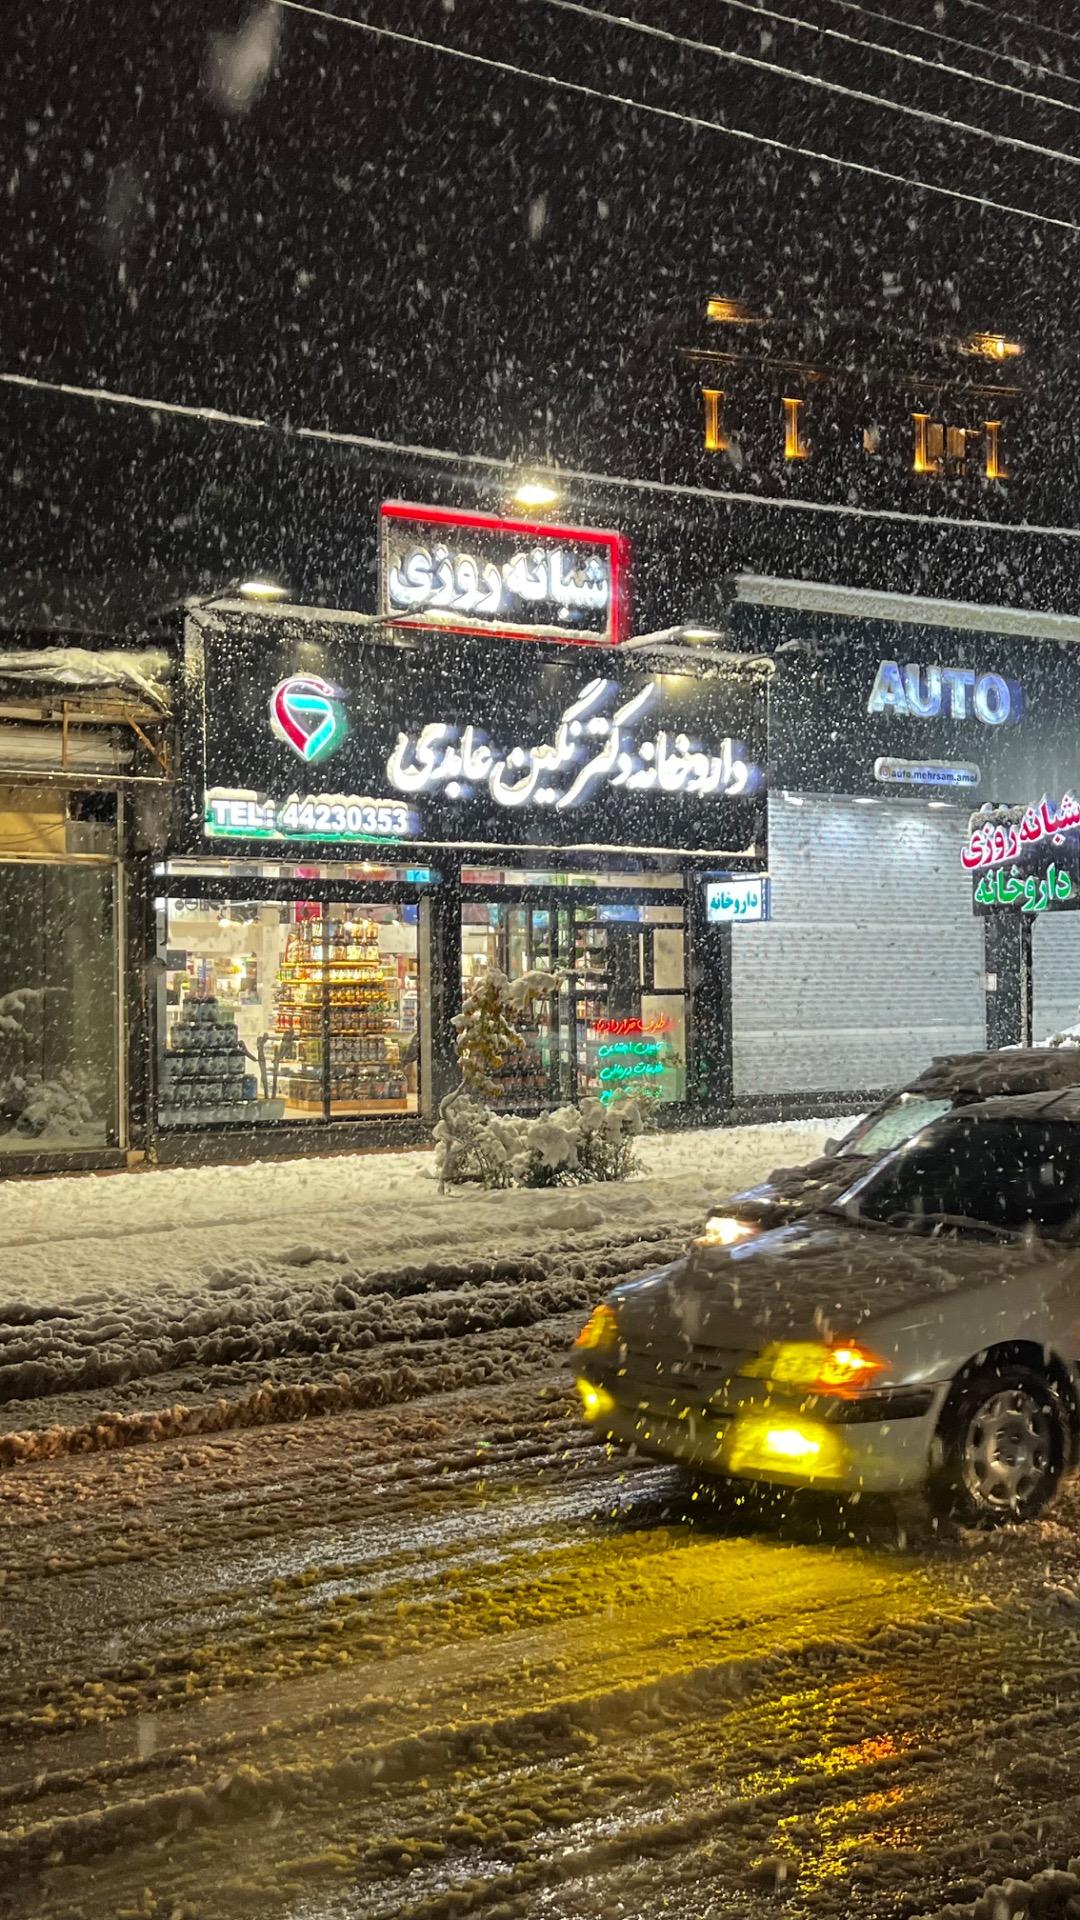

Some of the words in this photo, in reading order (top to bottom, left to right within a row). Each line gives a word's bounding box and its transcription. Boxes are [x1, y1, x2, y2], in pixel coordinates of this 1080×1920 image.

[388, 545, 501, 613] روزی
[503, 548, 610, 621] شبانه
[867, 660, 1011, 725] AUTO
[386, 722, 493, 799] عابدی
[489, 677, 608, 806] نگین
[556, 681, 655, 813] دکتر
[627, 730, 749, 796] داروخانه
[211, 799, 275, 828] TEL:
[282, 800, 409, 834] 44230353
[961, 822, 1021, 870] روزی
[710, 890, 758, 914] داروخانه
[974, 862, 1072, 913] داروخانه
[600, 1063, 633, 1080] درمانی
[634, 1061, 664, 1074] خدمات
